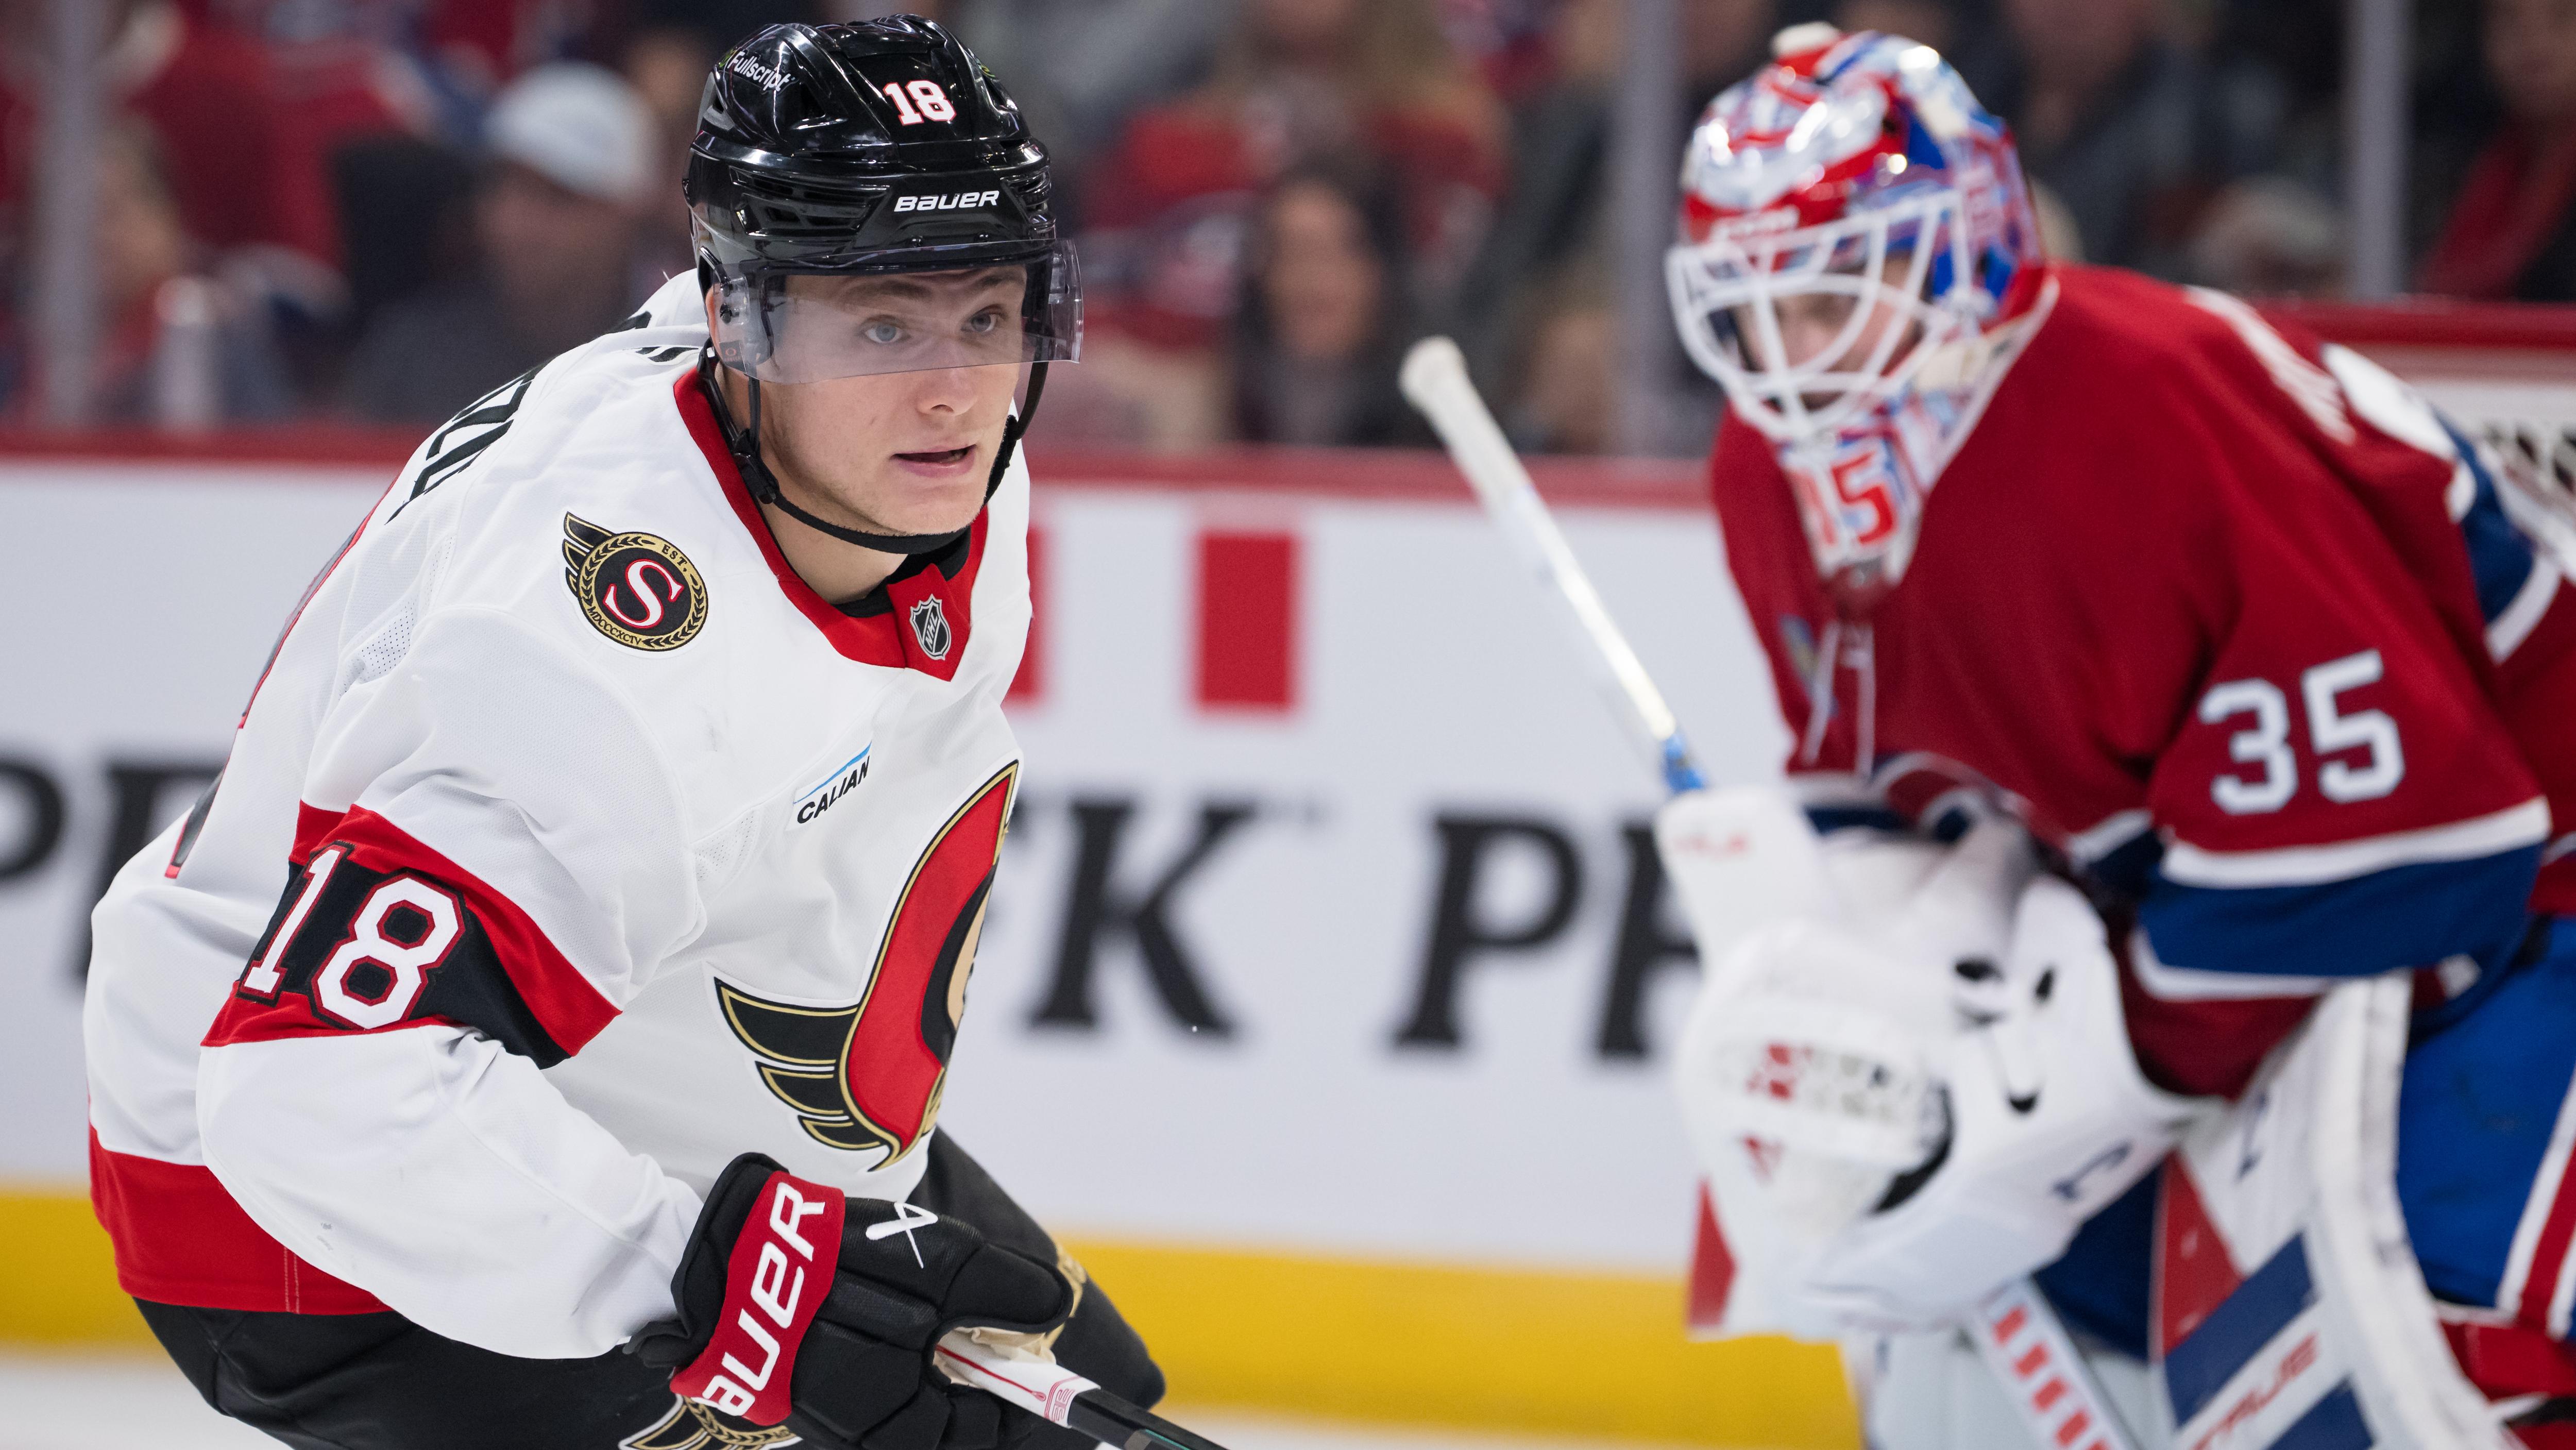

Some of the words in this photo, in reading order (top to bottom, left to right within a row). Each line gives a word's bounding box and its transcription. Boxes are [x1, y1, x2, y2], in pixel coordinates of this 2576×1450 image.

[727, 50, 792, 92] Fullscript
[883, 80, 957, 126] 18
[893, 190, 999, 213] BAUER
[662, 544, 687, 572] EST.
[603, 559, 685, 629] S
[925, 612, 938, 651] NHL
[2197, 647, 2405, 816] 35
[796, 755, 870, 825] CALIAN
[238, 843, 465, 1030] 18
